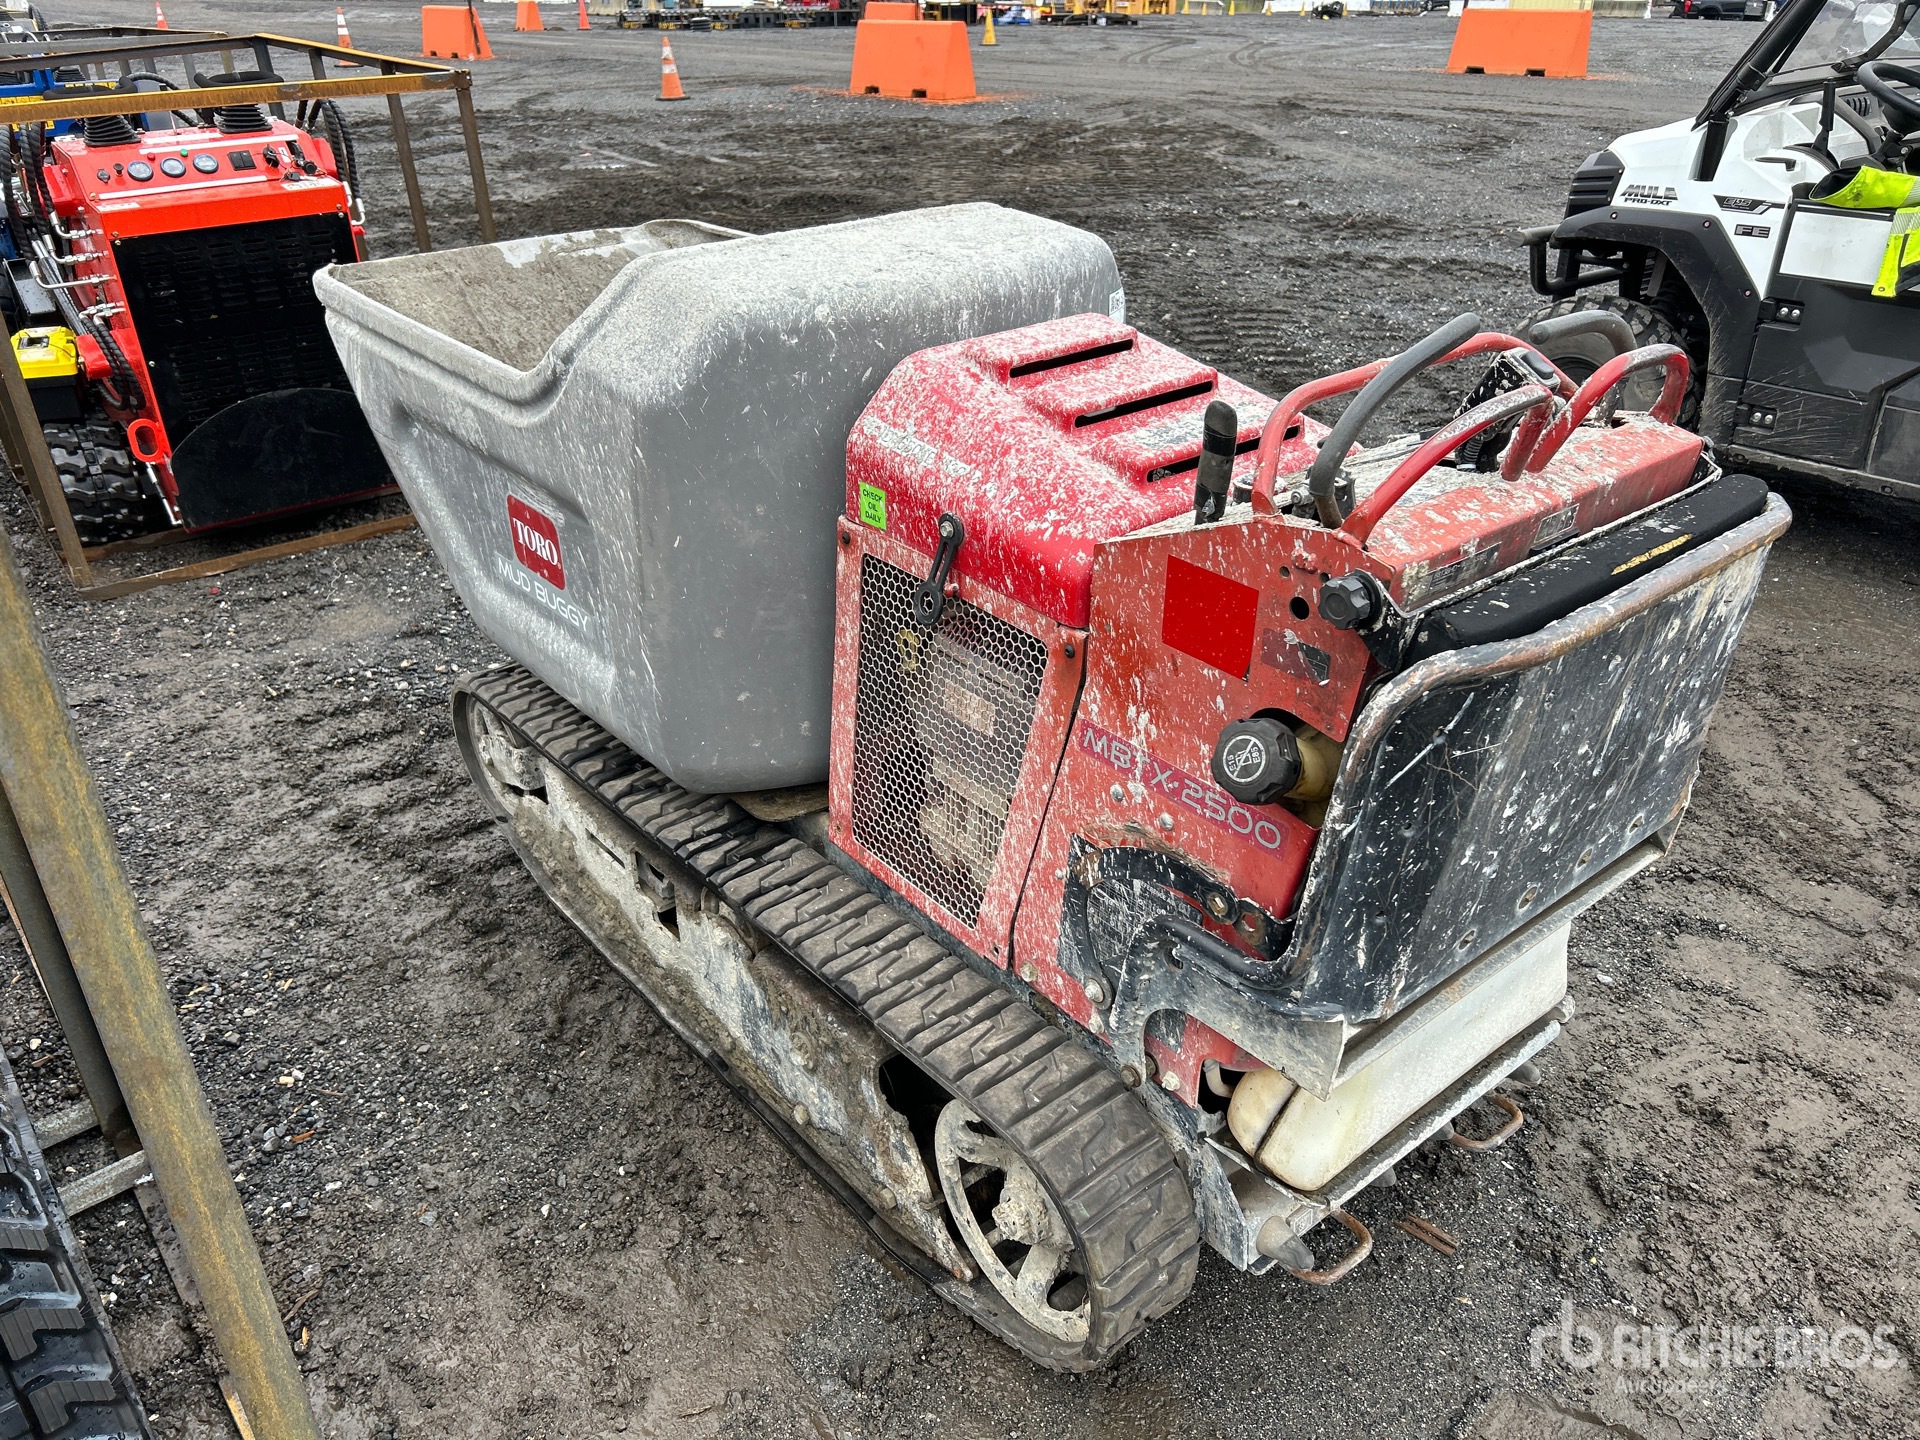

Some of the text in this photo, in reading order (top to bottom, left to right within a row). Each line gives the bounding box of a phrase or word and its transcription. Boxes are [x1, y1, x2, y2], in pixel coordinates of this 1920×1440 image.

[1620, 184, 1678, 200] MULE
[1623, 197, 1673, 206] PRO-DXT
[1735, 225, 1770, 237] FE
[862, 488, 883, 502] CHECK
[865, 510, 882, 523] DAILY
[512, 517, 559, 566] TORO
[498, 557, 588, 632] MUD BUGGY
[1227, 754, 1237, 771] E15
[1250, 746, 1261, 763] E85
